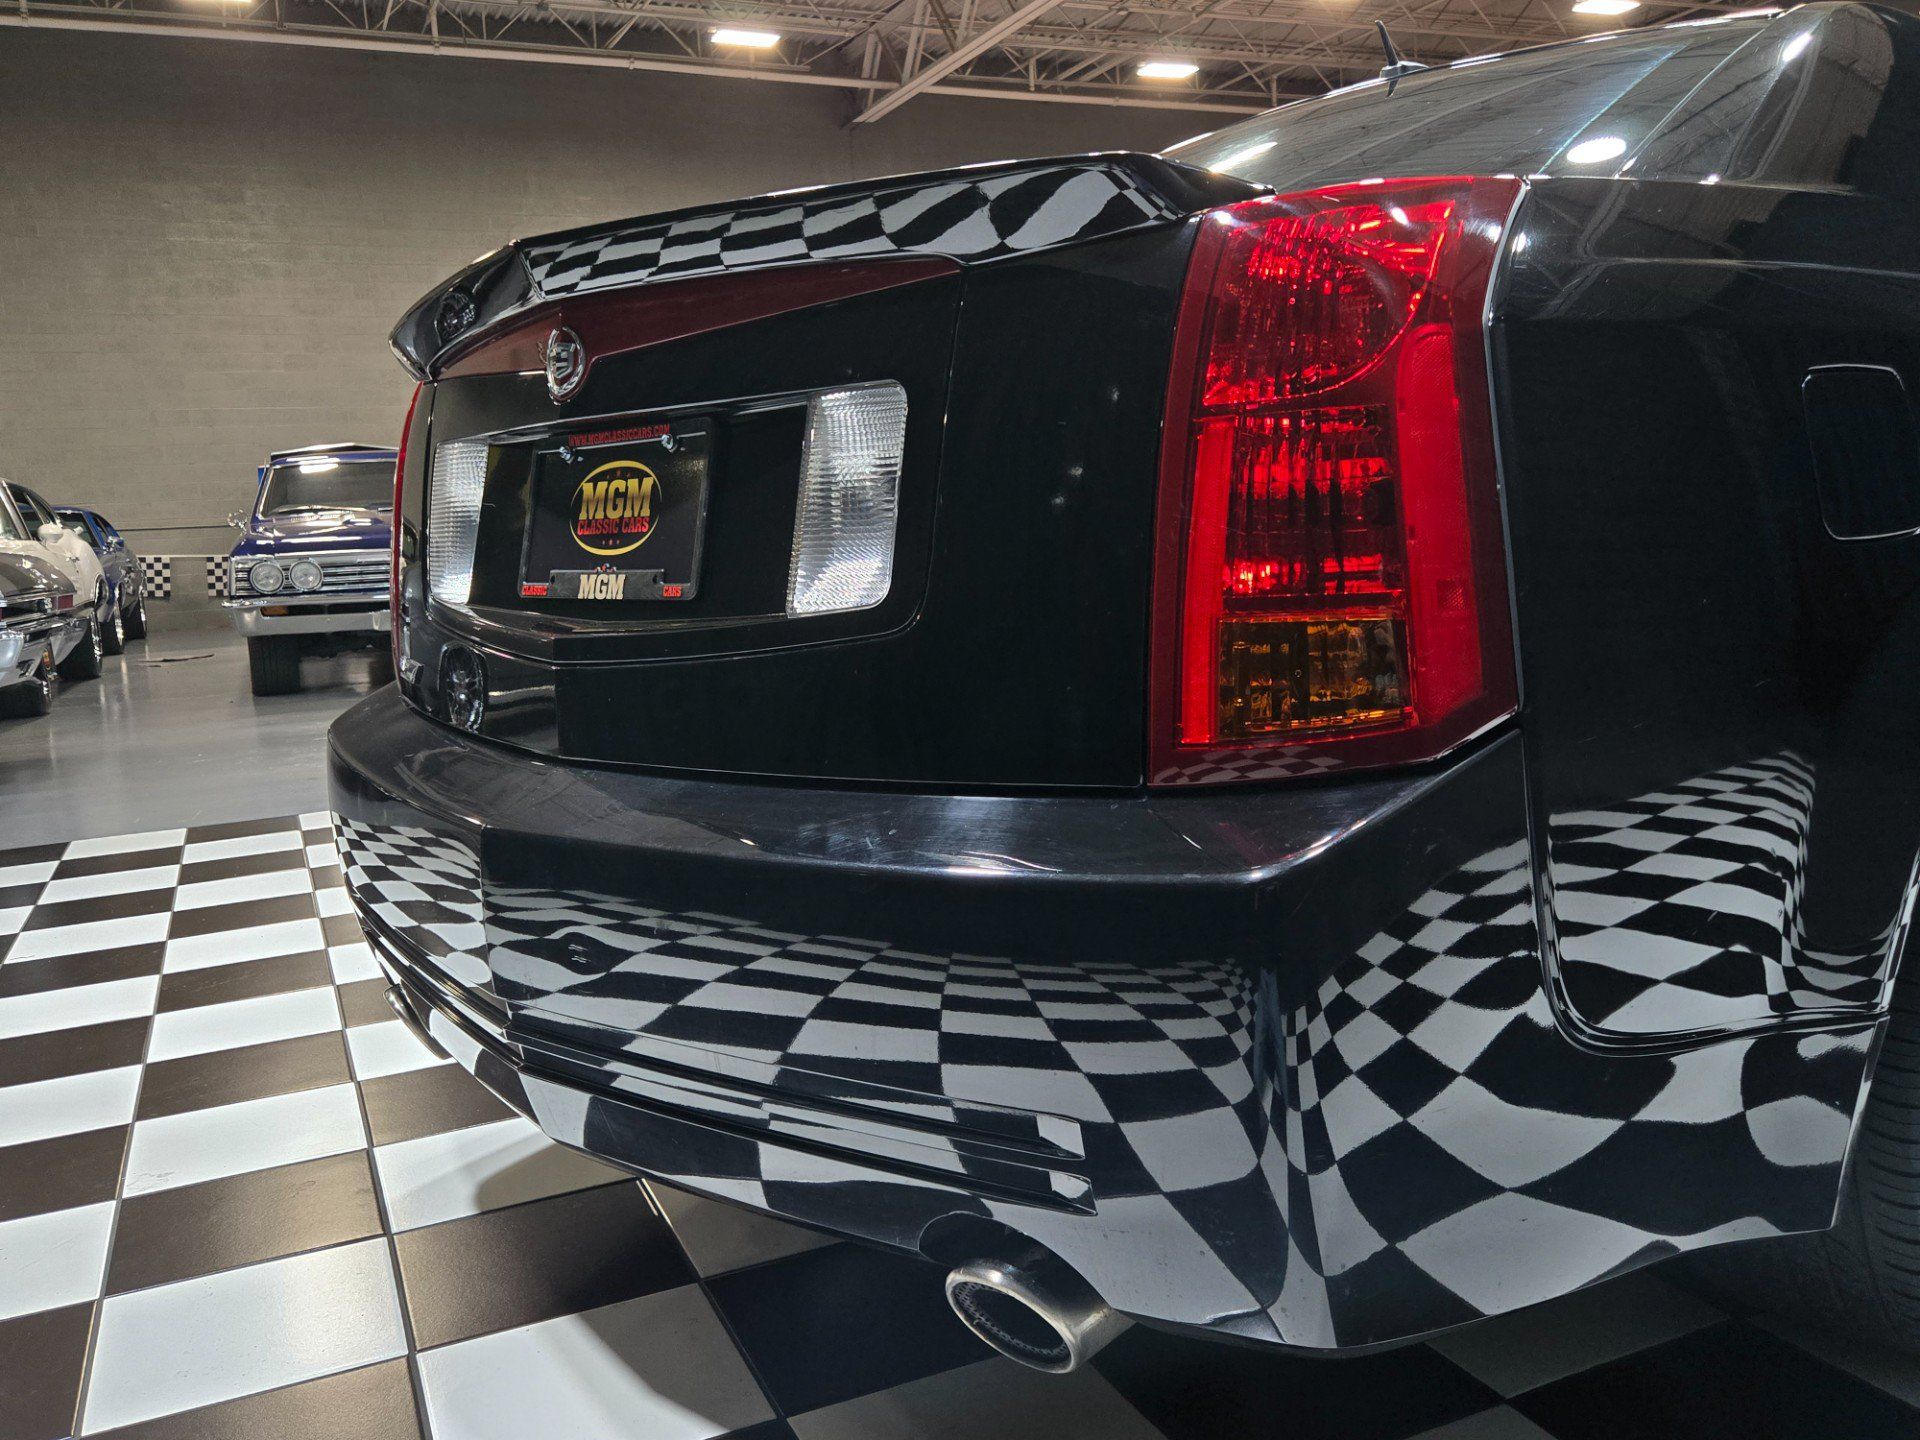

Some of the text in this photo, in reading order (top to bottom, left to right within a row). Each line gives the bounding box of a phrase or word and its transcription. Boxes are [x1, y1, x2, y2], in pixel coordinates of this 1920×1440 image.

[579, 476, 654, 520] MGM
[577, 517, 650, 535] CLASSIC CARS
[521, 573, 682, 600] CLASSIC MGM CARS
